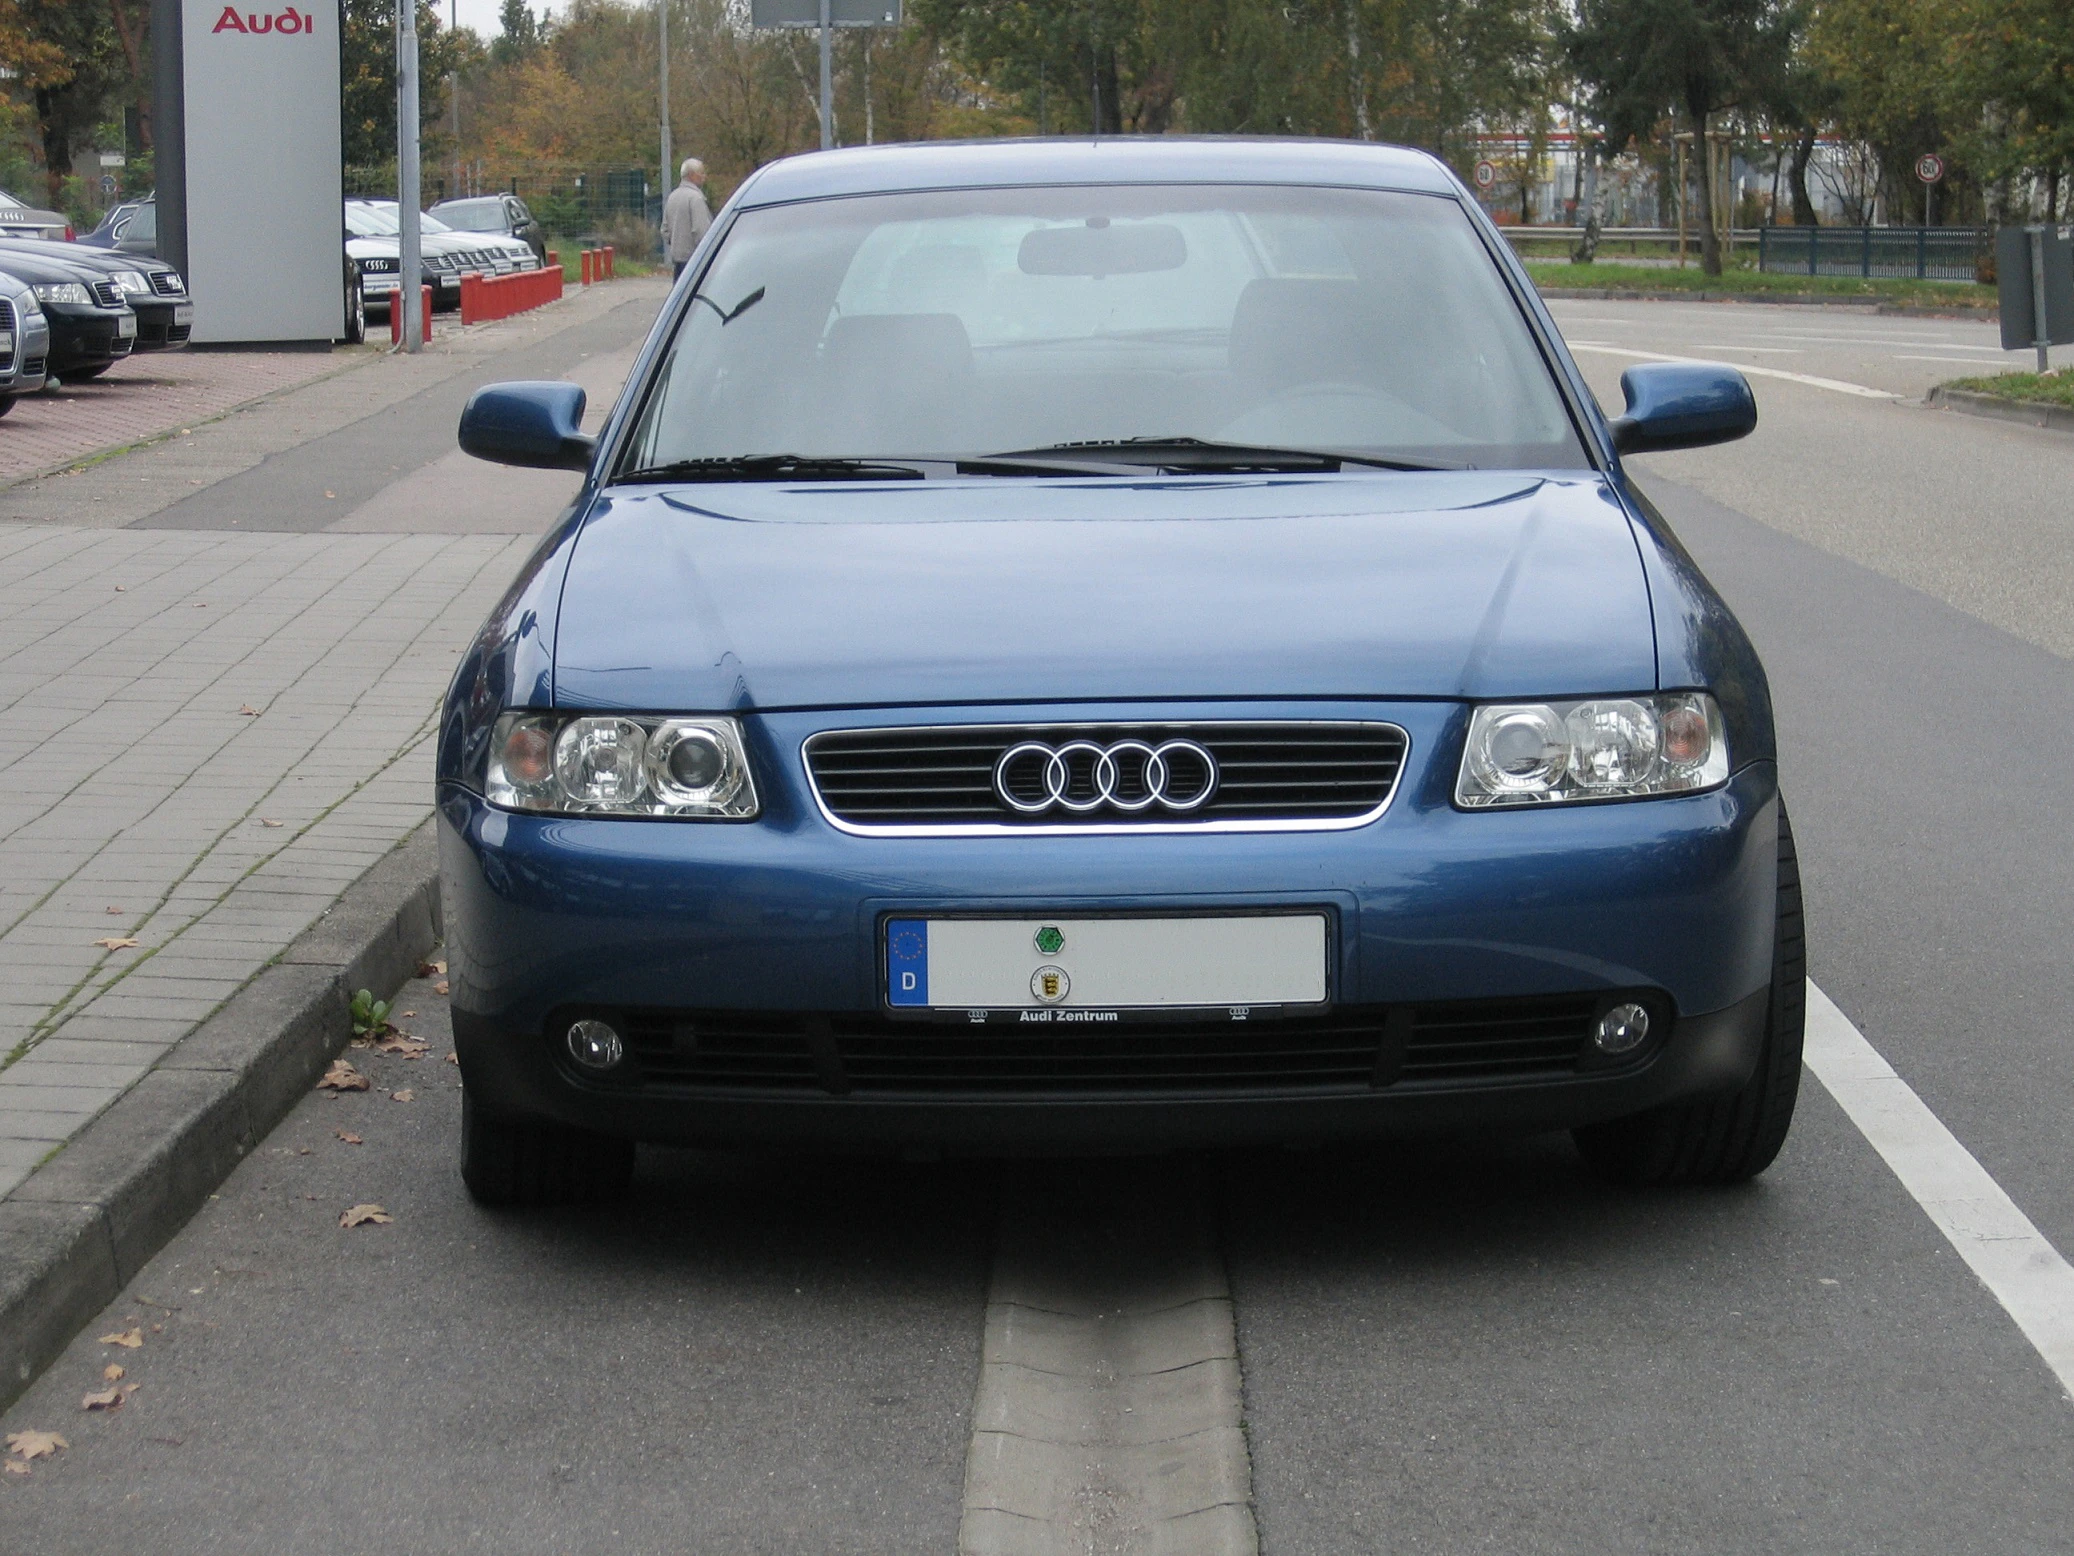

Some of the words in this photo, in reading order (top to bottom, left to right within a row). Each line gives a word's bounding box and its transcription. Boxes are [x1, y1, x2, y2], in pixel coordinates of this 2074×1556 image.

[211, 6, 313, 34] Audi
[902, 971, 916, 990] D
[1019, 1010, 1052, 1022] Audi
[1056, 1010, 1118, 1022] Zentrum
